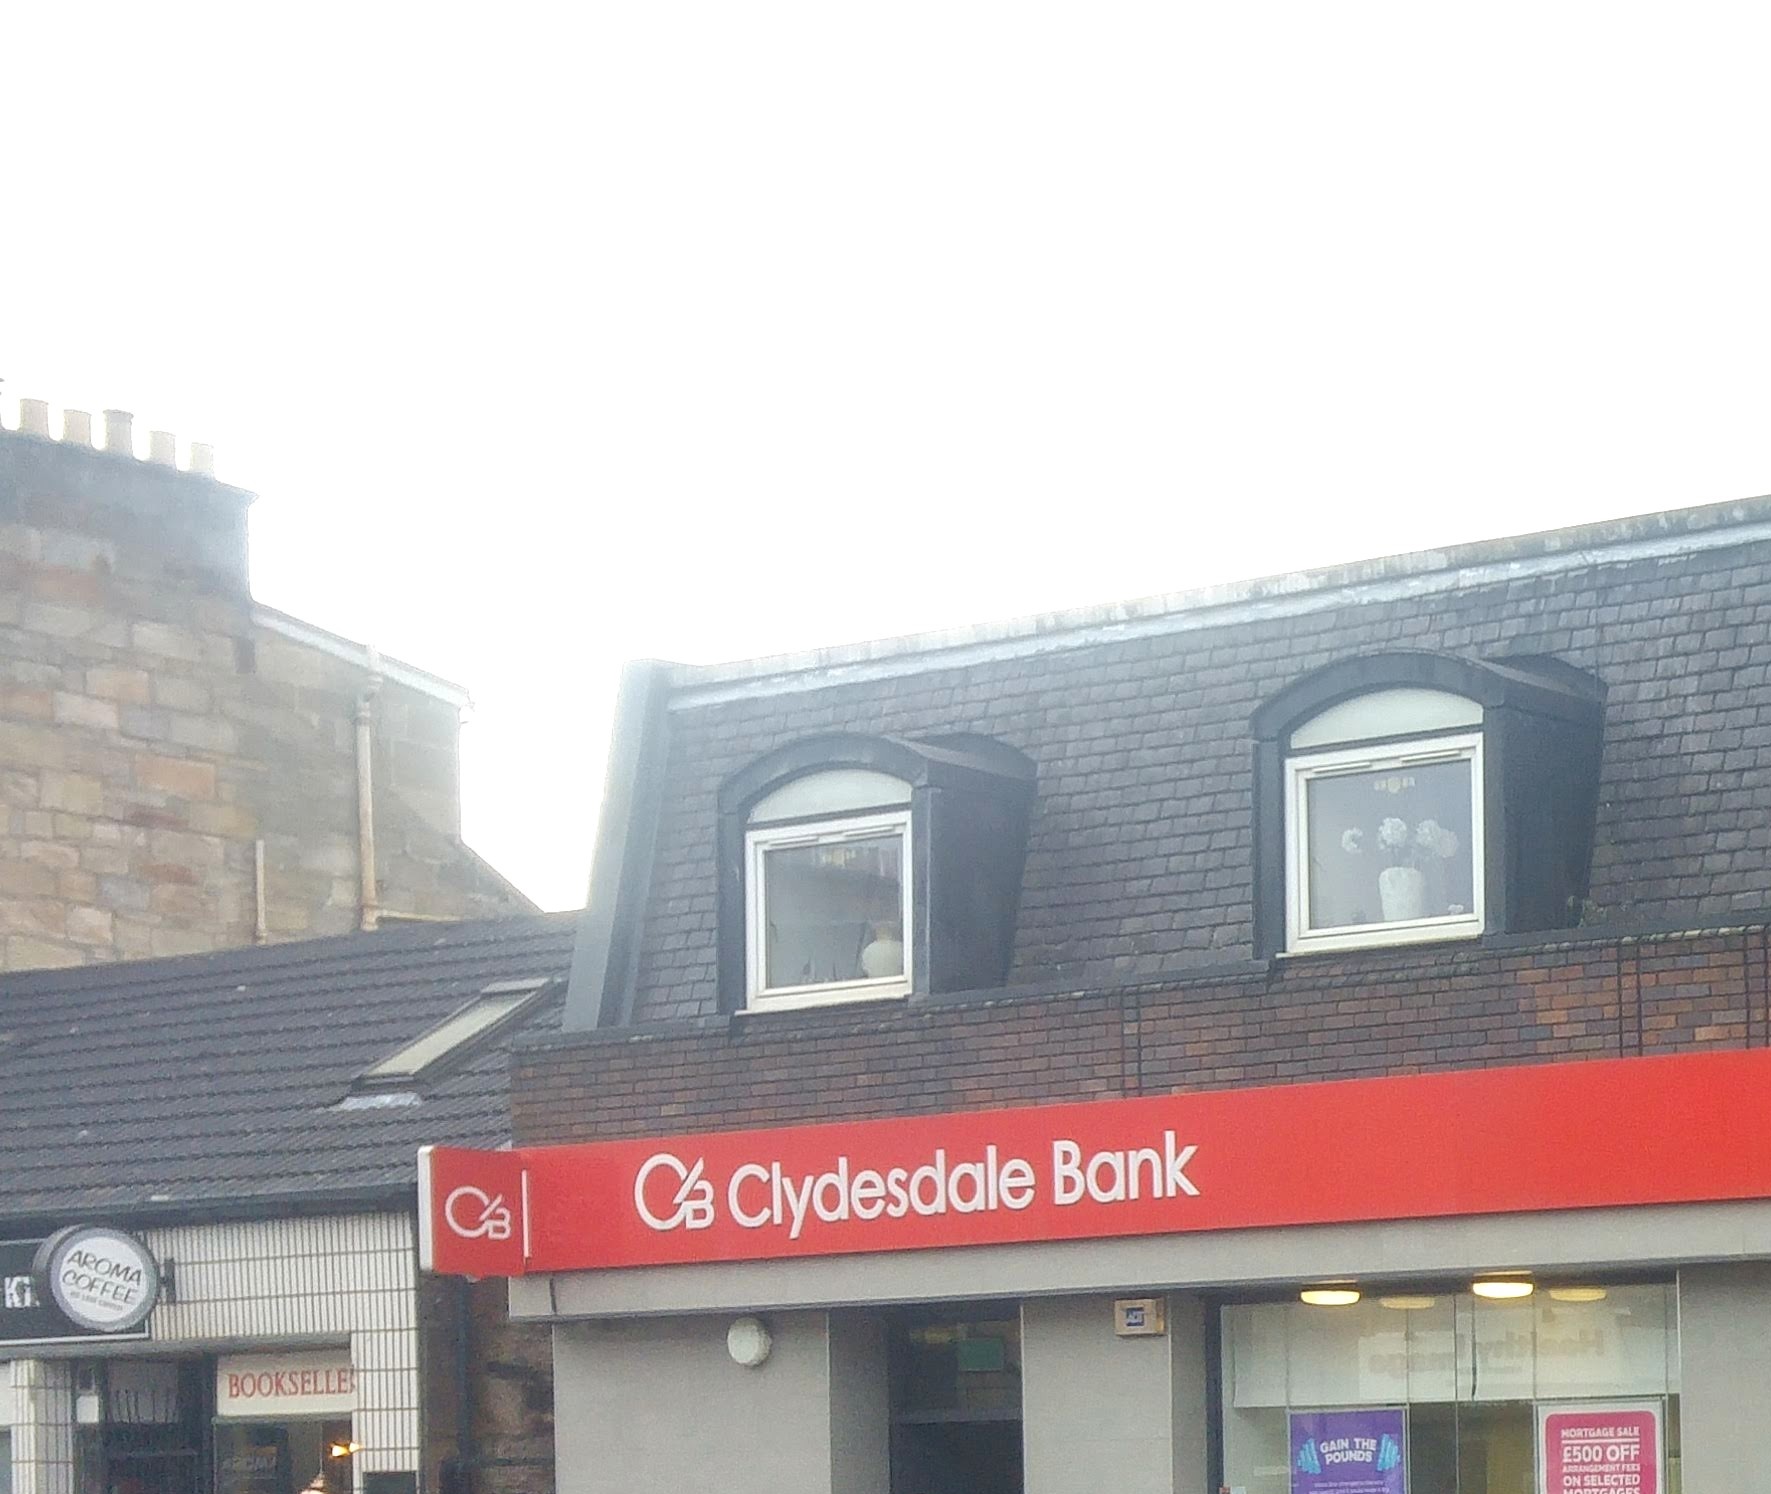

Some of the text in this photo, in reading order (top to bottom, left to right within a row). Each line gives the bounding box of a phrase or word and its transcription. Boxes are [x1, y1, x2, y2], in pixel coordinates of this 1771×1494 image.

[728, 1144, 1037, 1240] Clydesdale
[1052, 1130, 1201, 1207] Bank
[66, 1249, 143, 1287] AROMA
[61, 1269, 140, 1304] COFFEE
[1561, 1426, 1641, 1438] MORTGAGE SALE
[1320, 1438, 1378, 1454] GAIN THE
[1563, 1444, 1641, 1463] £500 OFF
[1325, 1451, 1373, 1465] POUNDS
[1563, 1474, 1641, 1487] ON SELECTED
